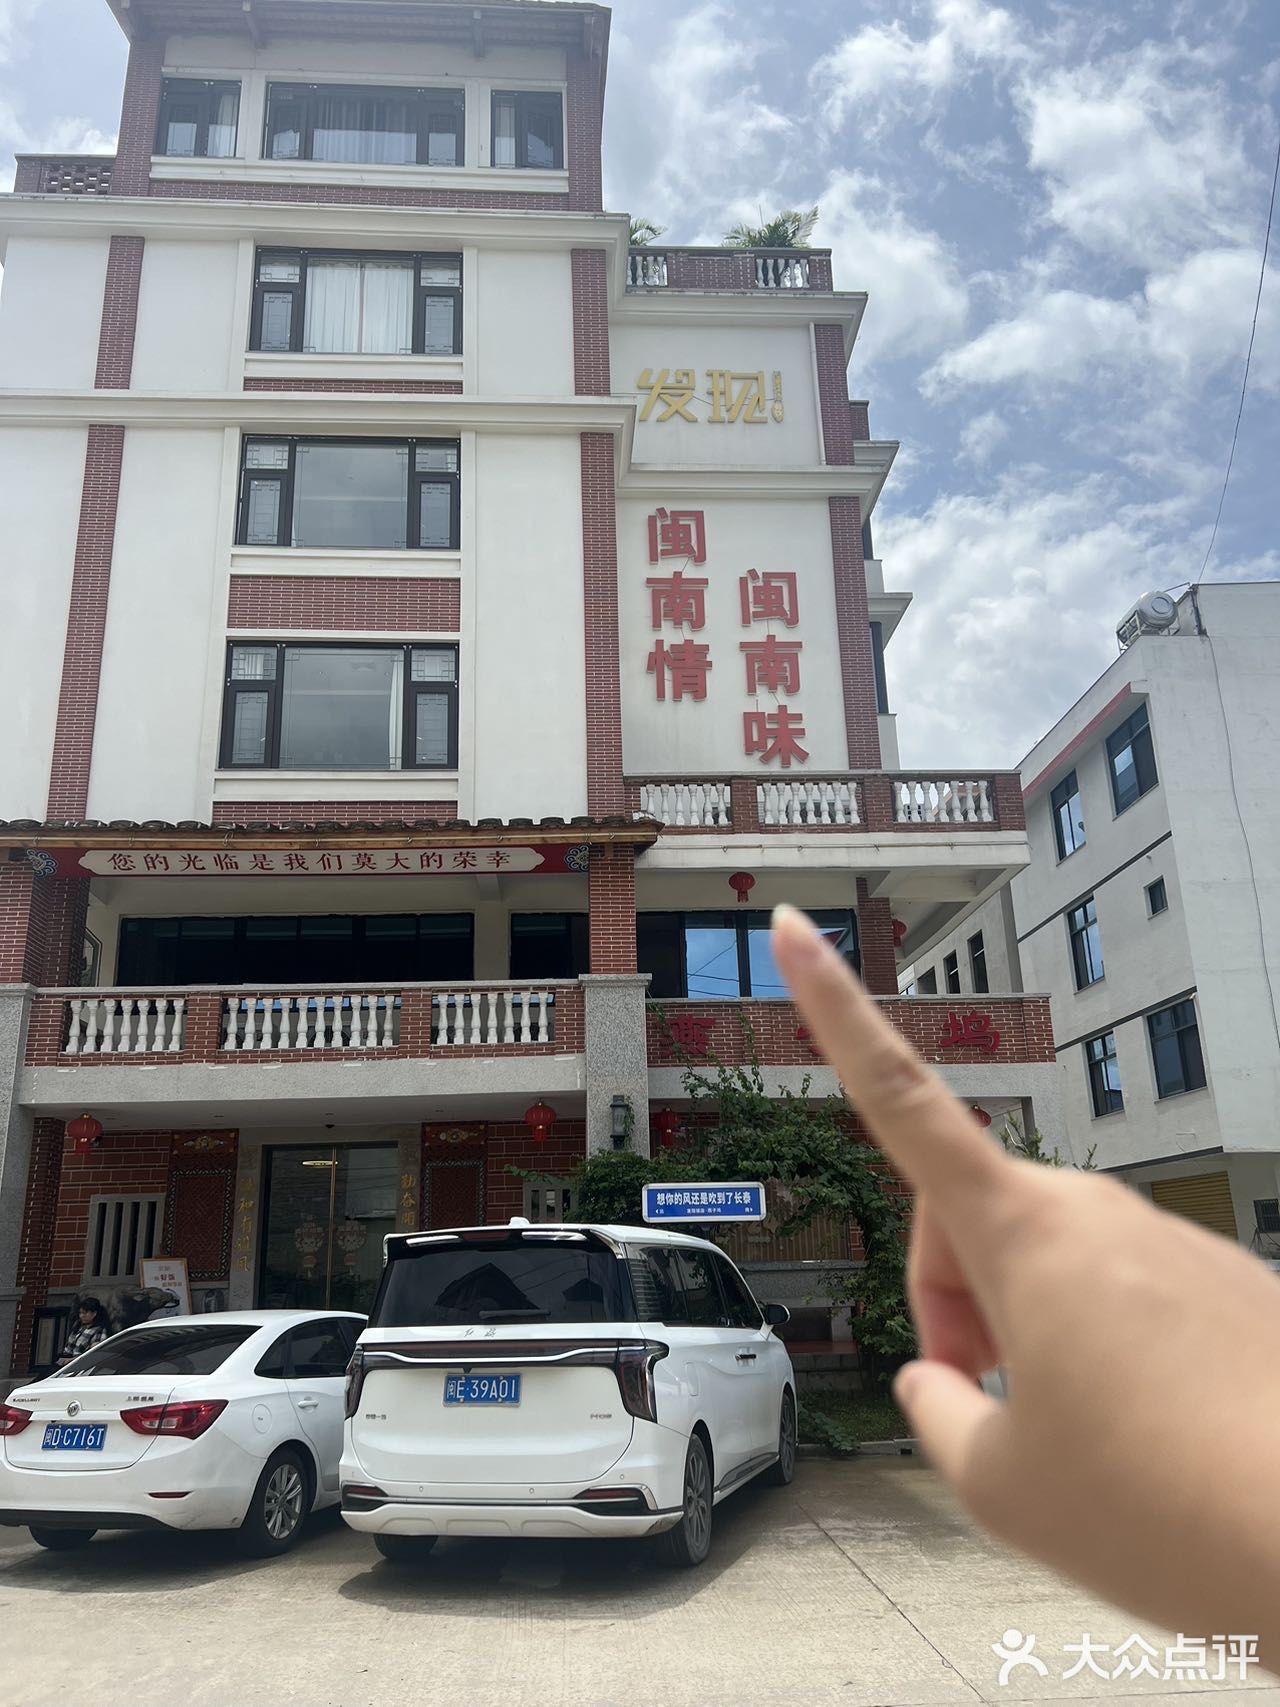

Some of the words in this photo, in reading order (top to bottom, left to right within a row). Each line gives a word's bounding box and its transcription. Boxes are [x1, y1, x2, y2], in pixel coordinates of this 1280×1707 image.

[645, 506, 713, 702] 闽南情
[738, 567, 809, 769] 闽南味
[107, 850, 512, 872] 您的光临是我们莫大的荣幸
[656, 1191, 752, 1206] 想你的风还是吹到了长泰
